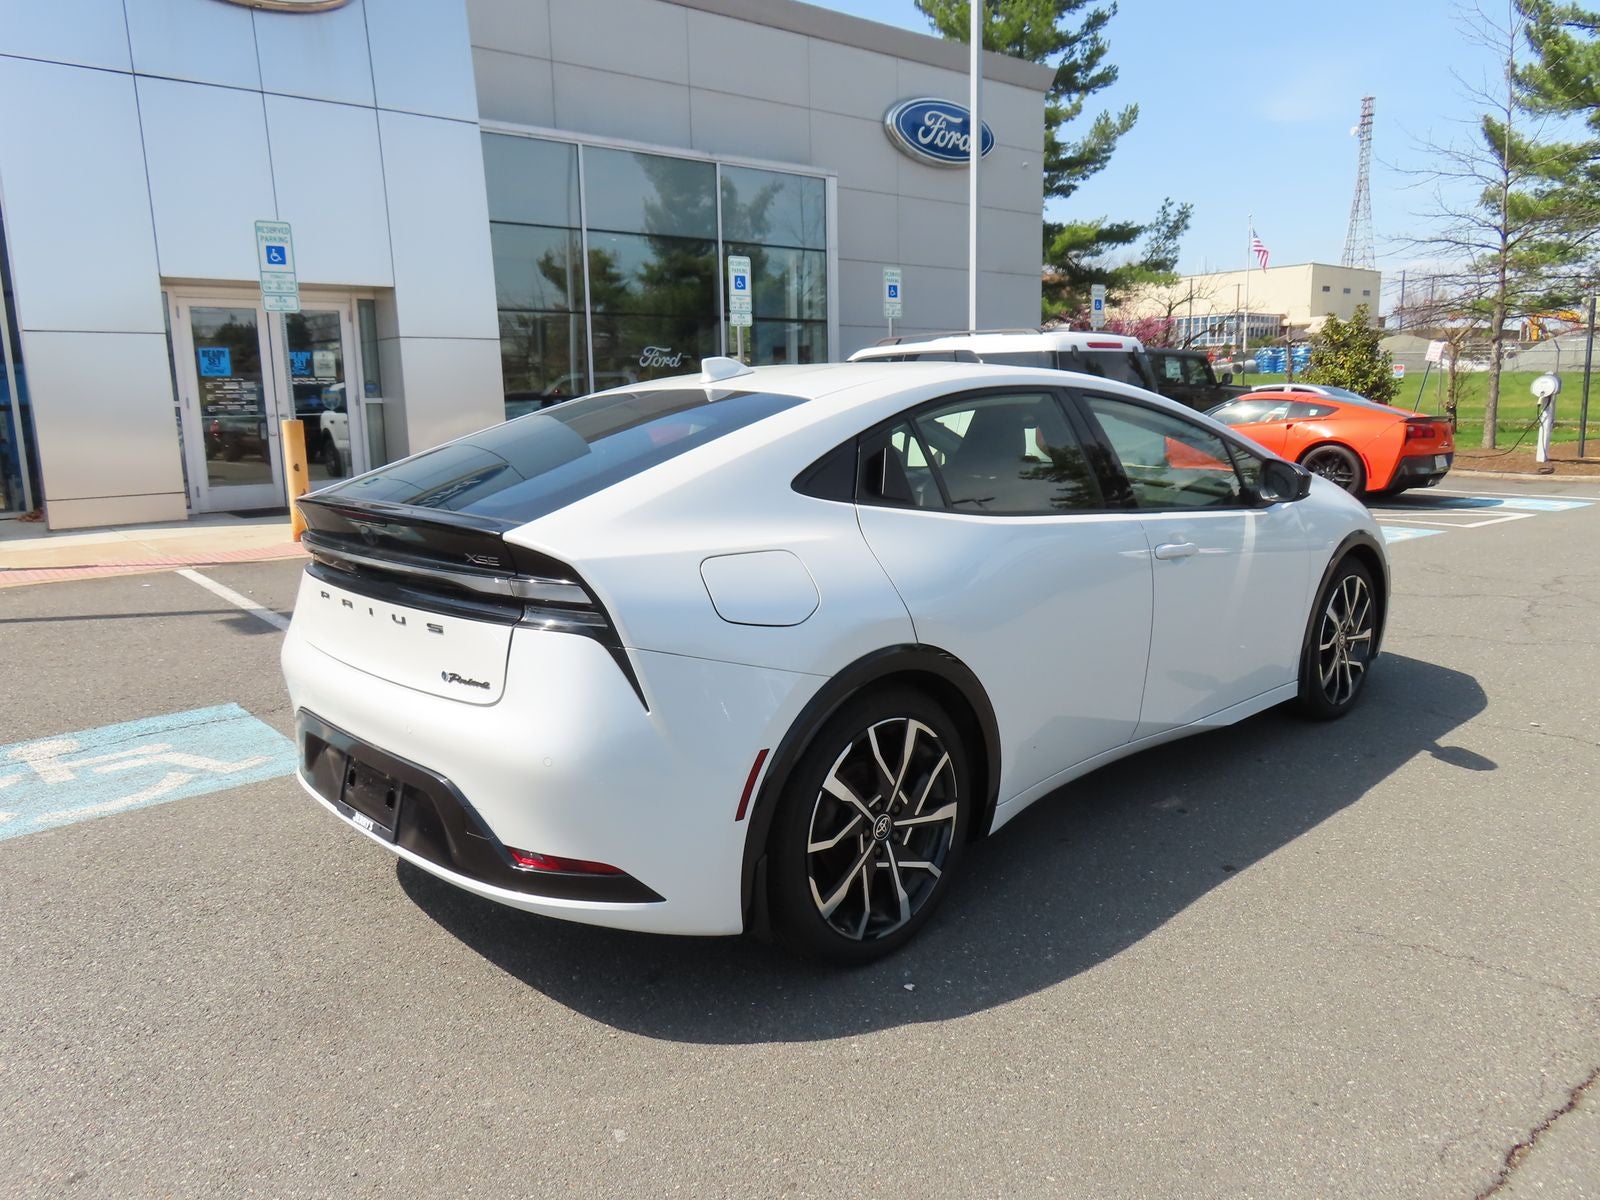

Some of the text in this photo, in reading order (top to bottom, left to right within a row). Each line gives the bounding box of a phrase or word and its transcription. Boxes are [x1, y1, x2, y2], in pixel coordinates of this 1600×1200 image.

[256, 225, 290, 235] RESERVED
[259, 235, 289, 243] PARKING
[639, 346, 682, 368] Ford
[465, 553, 500, 567] XSE
[320, 590, 445, 635] PRIUS
[448, 672, 491, 690] Prime
